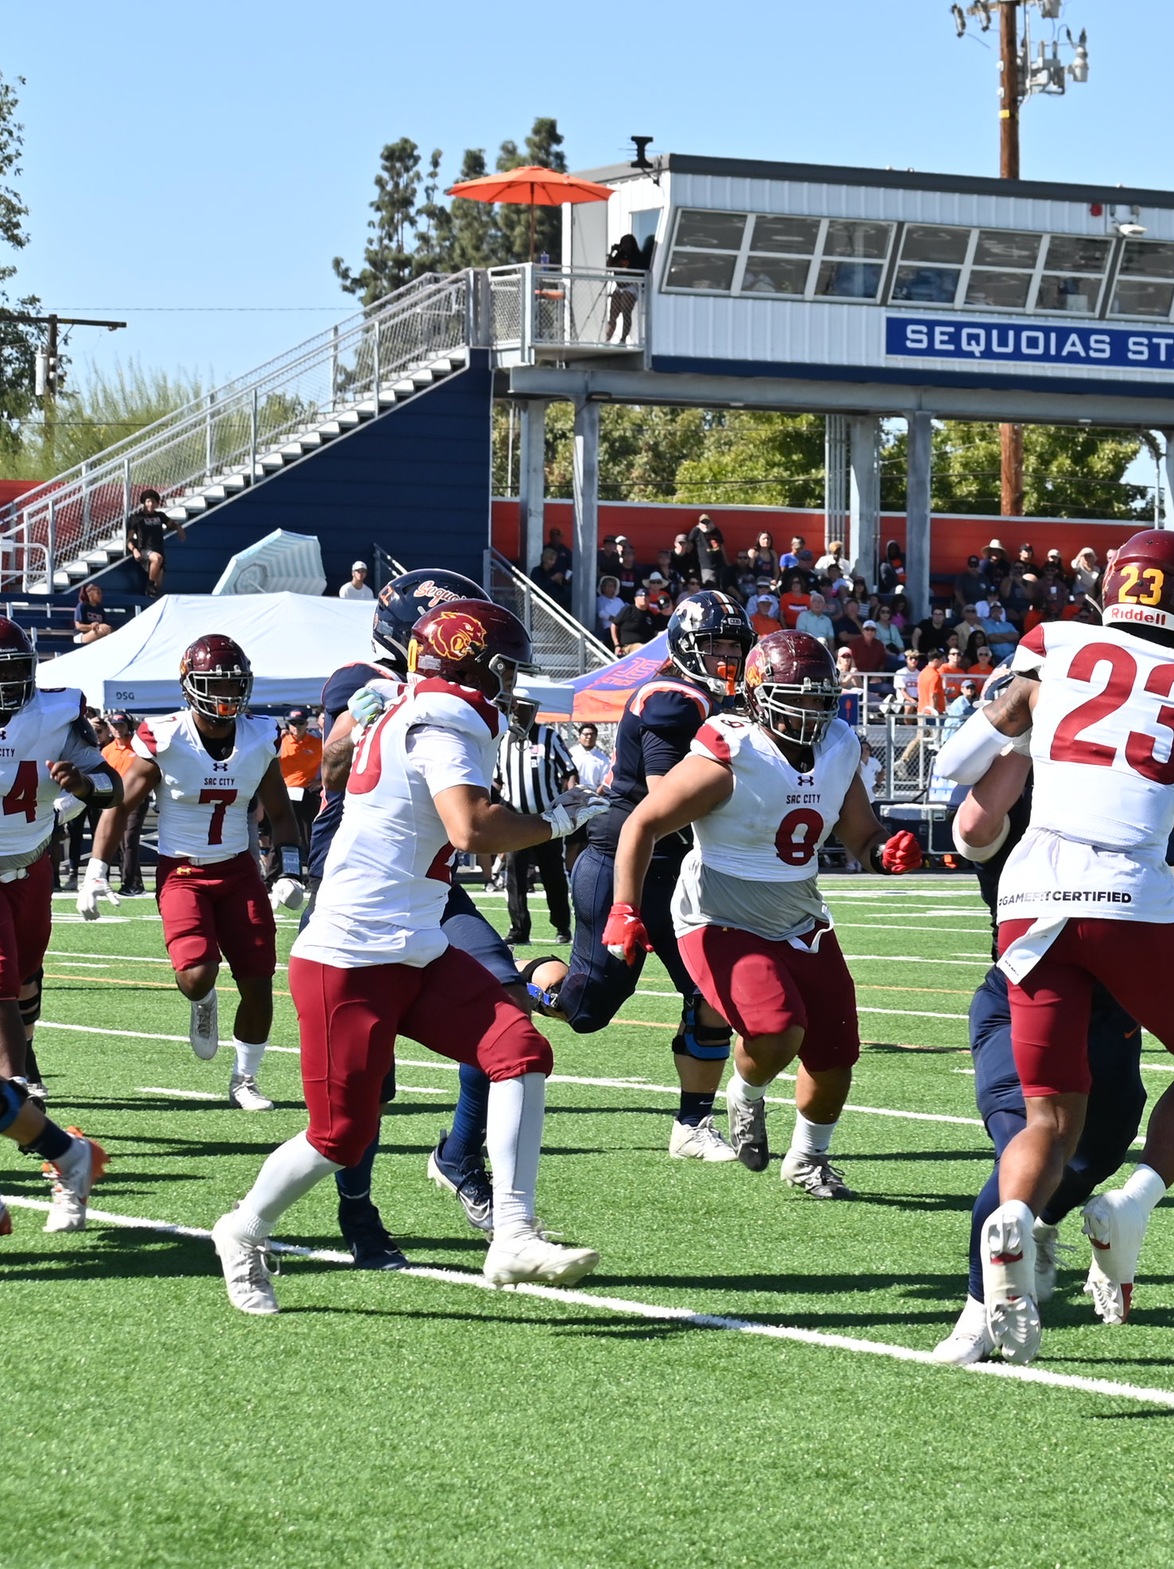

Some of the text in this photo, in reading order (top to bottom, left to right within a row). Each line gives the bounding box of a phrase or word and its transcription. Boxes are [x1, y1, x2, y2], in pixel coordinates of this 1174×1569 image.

[906, 324, 1111, 358] SEQUOIAS
[1118, 565, 1165, 606] 23
[1111, 607, 1167, 626] Riddell
[116, 691, 135, 701] DSG
[204, 777, 235, 786] SAC CITY
[786, 793, 821, 804] SAC CITY
[198, 788, 238, 846] 7
[774, 807, 824, 867] 8
